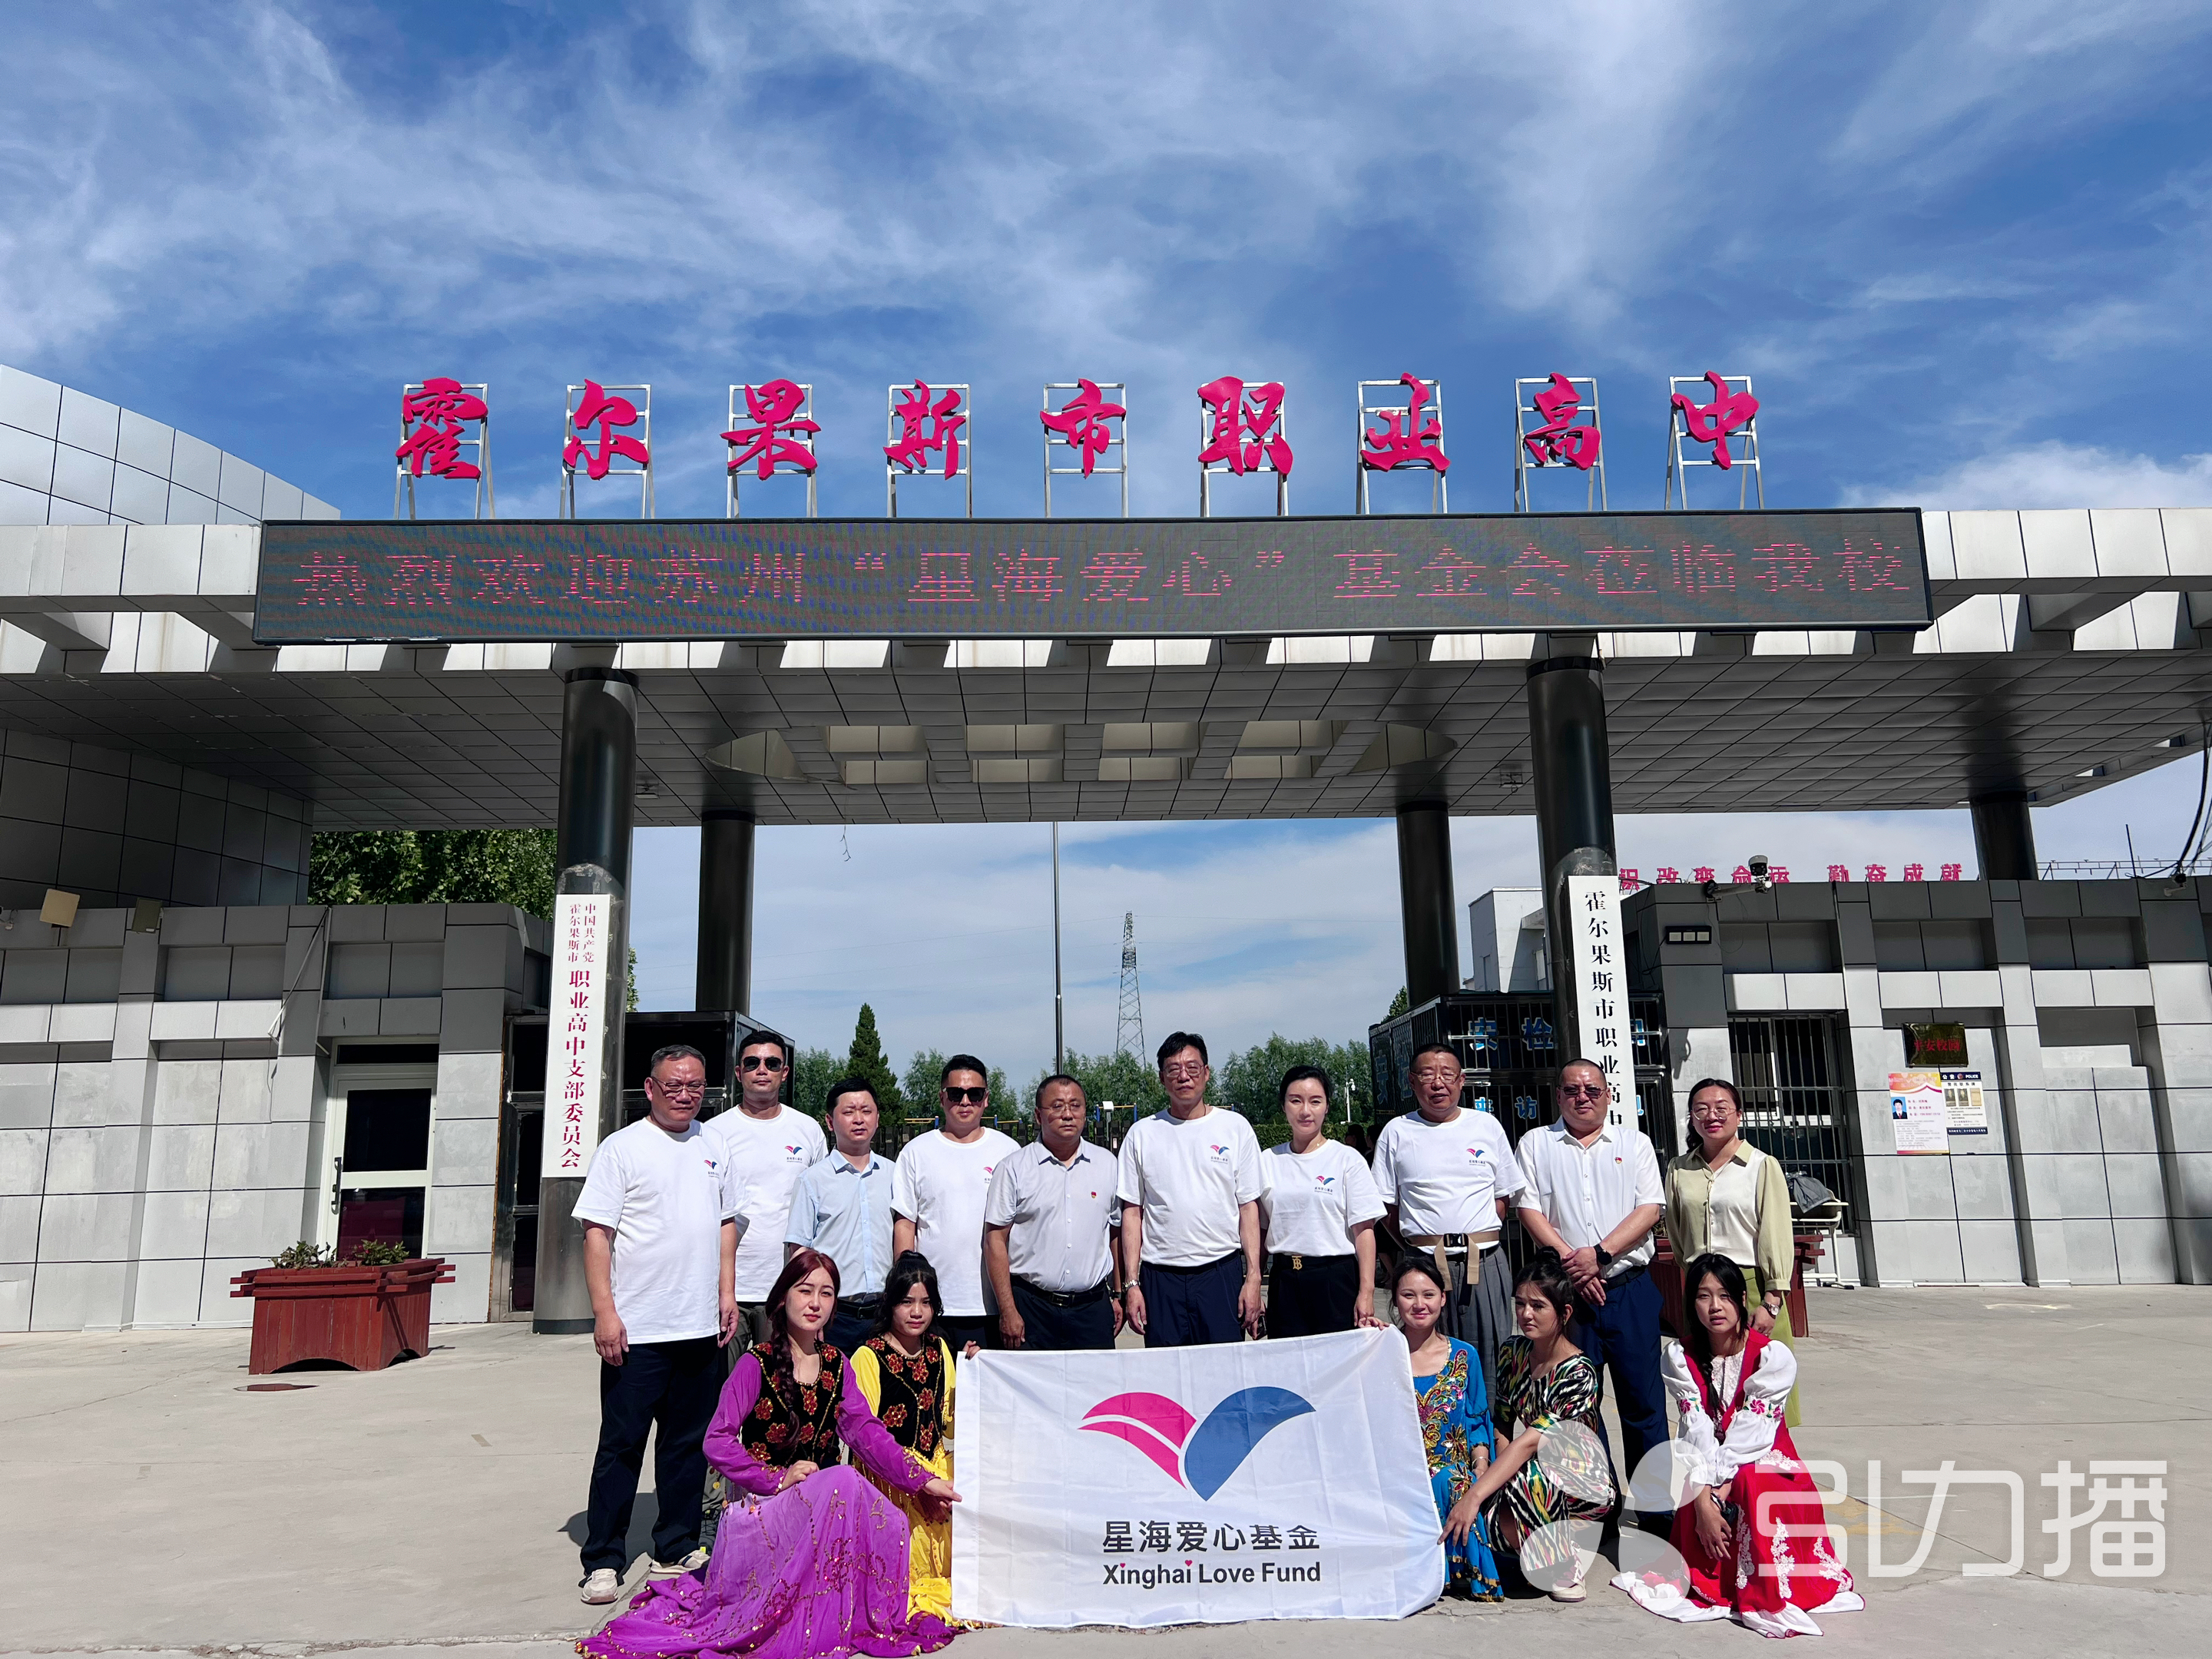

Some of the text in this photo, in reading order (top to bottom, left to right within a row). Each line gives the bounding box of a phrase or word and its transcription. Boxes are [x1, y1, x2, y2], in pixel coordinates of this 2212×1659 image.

[395, 372, 1760, 479] 霍尔果斯市职业高中
[567, 903, 581, 964] 霍尔果斯市
[582, 902, 597, 964] 中国共产党
[561, 969, 591, 1168] 职业高中支部委员会
[1102, 1520, 1320, 1553] 星海爱心基金
[1103, 1560, 1321, 1589] Xinghai Love Fund
